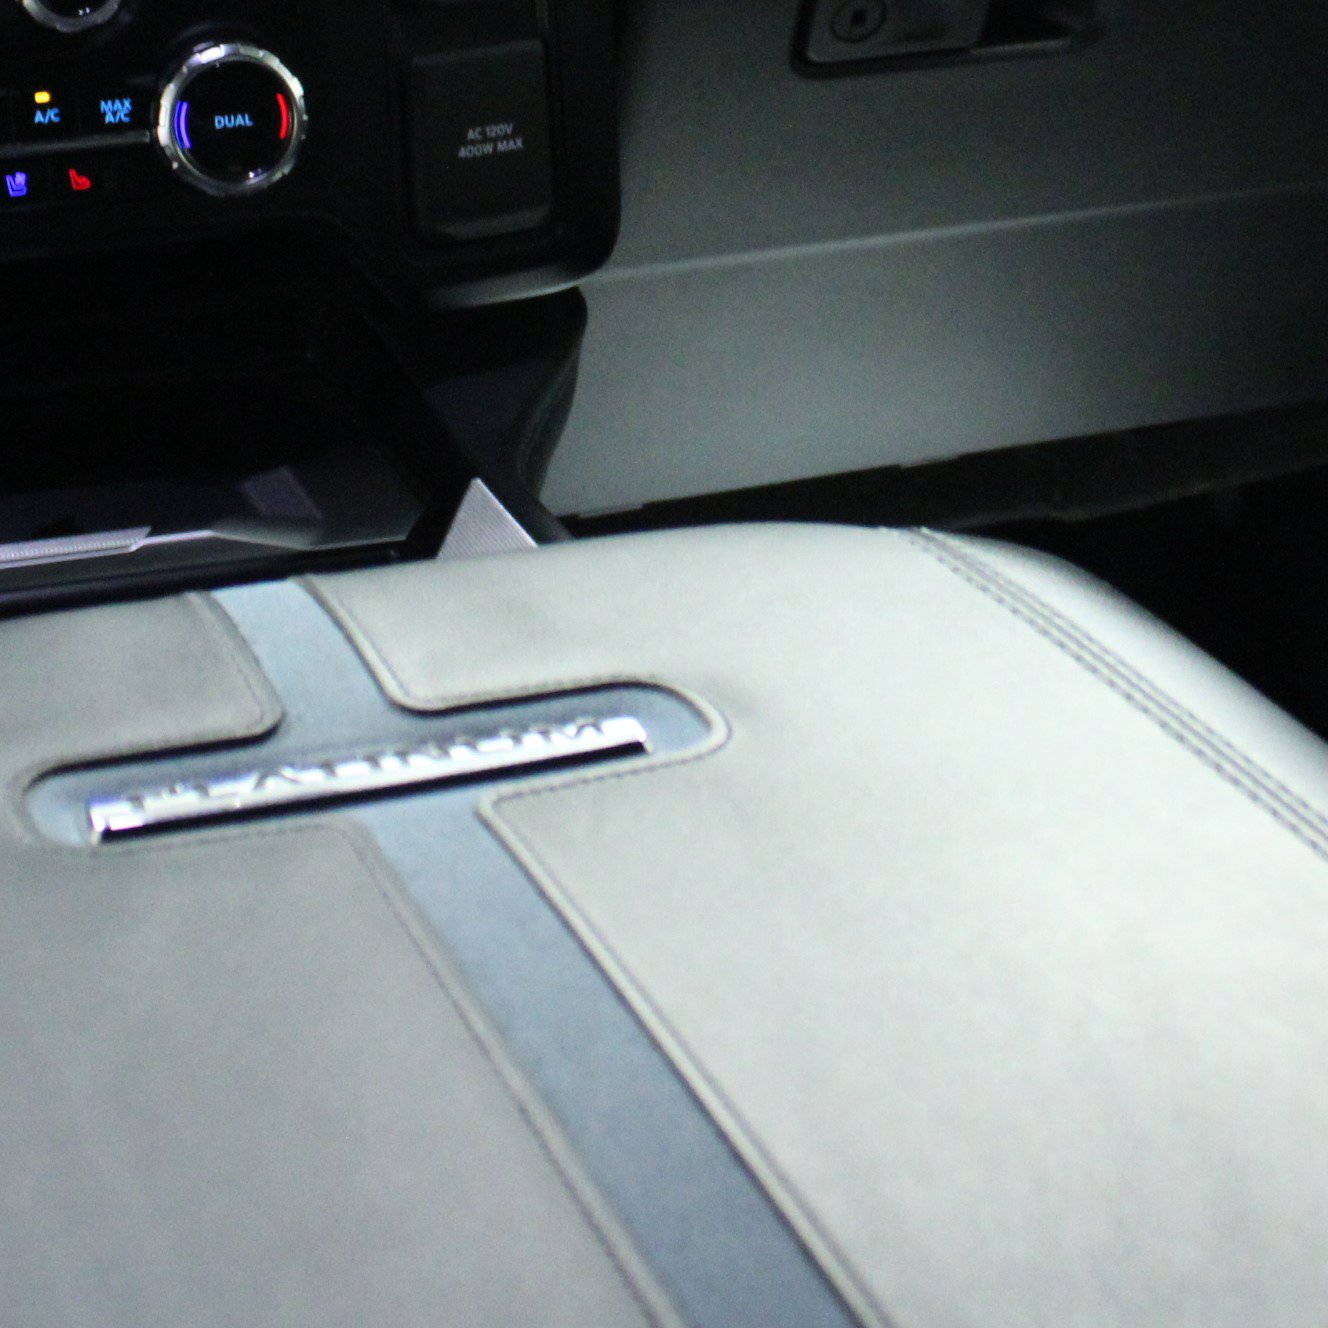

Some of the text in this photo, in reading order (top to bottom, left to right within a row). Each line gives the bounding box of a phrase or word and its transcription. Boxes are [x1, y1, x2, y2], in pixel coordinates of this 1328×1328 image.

[100, 98, 133, 113] MAX
[35, 108, 61, 124] A/C
[105, 109, 130, 124] A/C
[214, 114, 254, 129] DUAL
